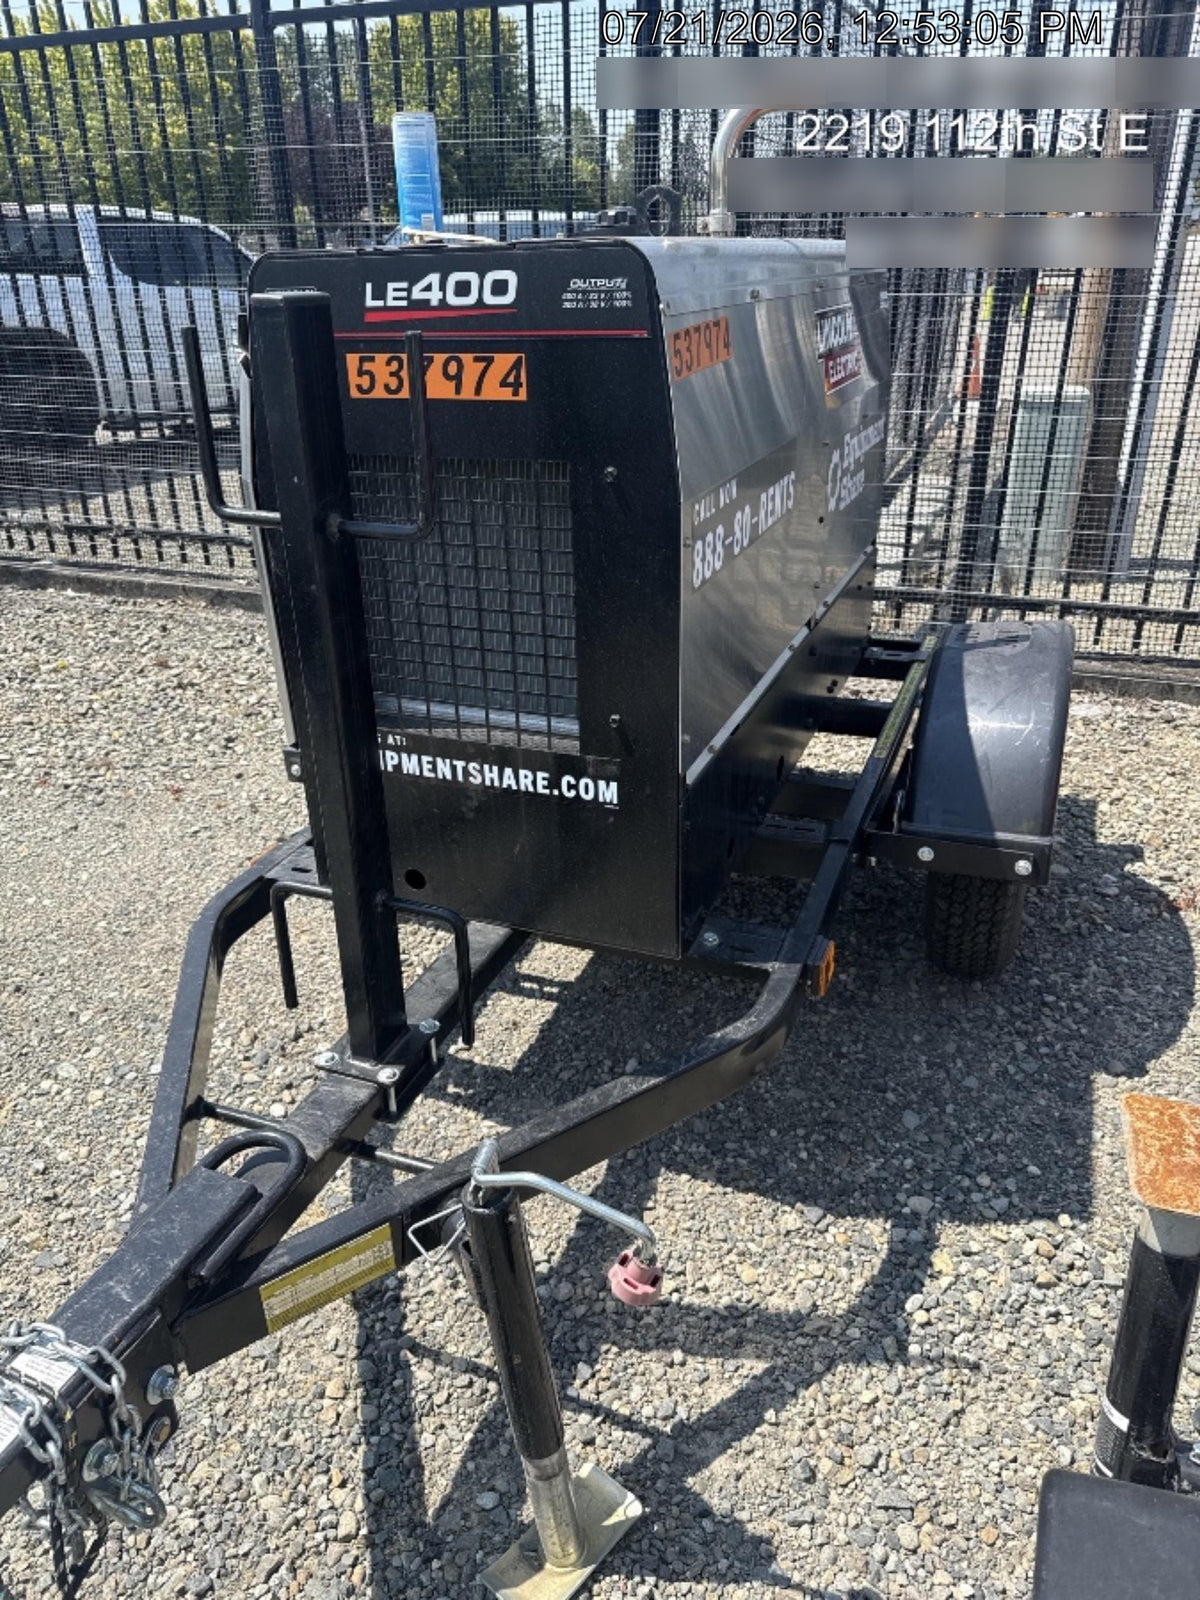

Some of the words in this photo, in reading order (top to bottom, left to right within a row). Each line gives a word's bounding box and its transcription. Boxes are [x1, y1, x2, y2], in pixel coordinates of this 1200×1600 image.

[364, 269, 518, 307] LE400
[569, 278, 624, 288] OUTPUT
[672, 318, 732, 379] 537974
[693, 492, 716, 526] CALL
[719, 479, 738, 510] NOW
[692, 470, 796, 589] 888-80-RENTS
[379, 749, 619, 804] IPMENTSHARE.COM
